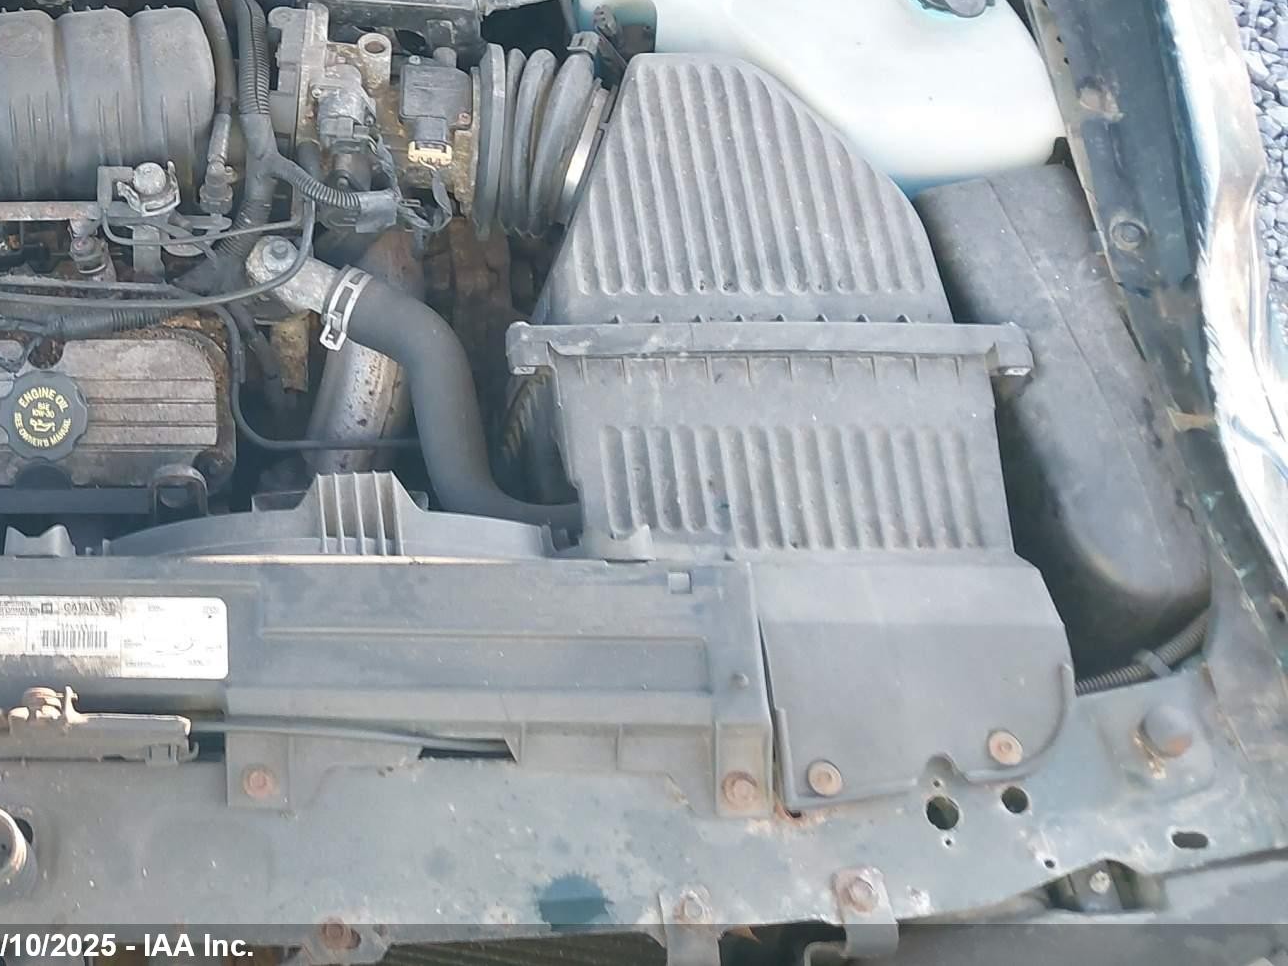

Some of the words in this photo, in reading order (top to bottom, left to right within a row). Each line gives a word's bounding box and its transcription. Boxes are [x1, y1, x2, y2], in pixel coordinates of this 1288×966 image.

[18, 387, 57, 408] ENGINE
[55, 394, 69, 413] OIL
[49, 417, 71, 446] MANUAL
